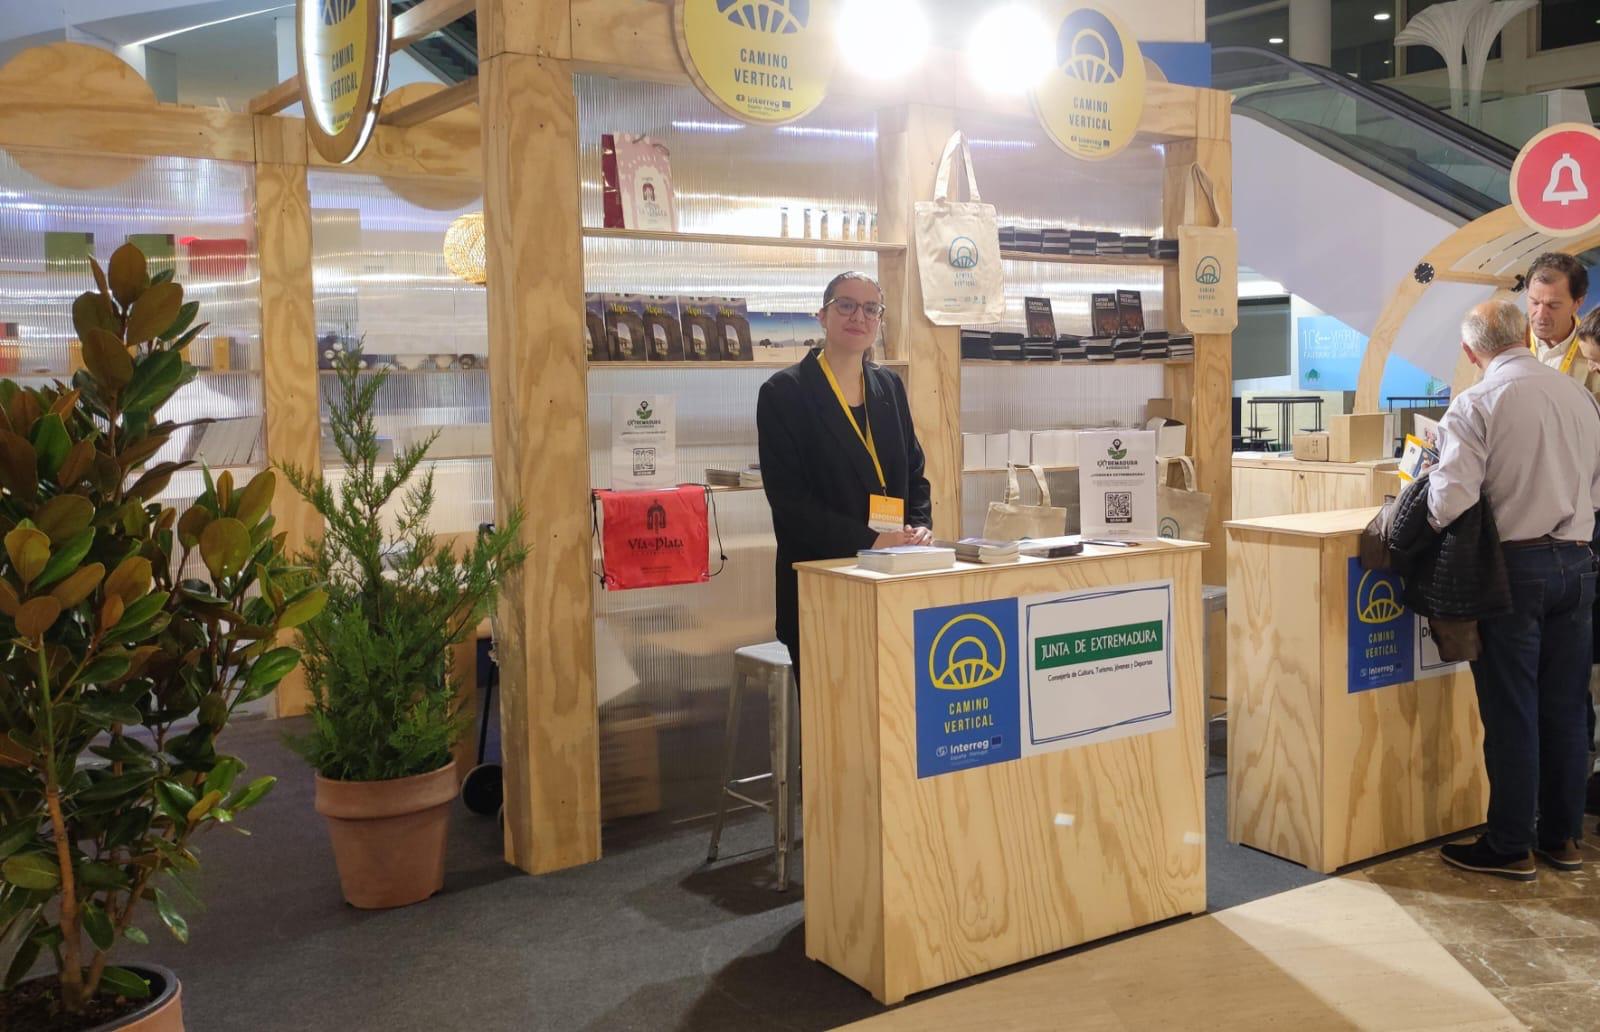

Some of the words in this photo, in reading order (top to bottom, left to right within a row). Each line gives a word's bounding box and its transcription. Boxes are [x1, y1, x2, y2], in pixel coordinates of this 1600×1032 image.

[331, 42, 354, 72] CAMINO
[740, 48, 788, 69] CAMINO
[330, 71, 358, 102] VERTICAL
[734, 68, 793, 91] VERTICAL
[1073, 96, 1108, 113] CAMINO
[1069, 112, 1112, 132] VERTICAL
[1041, 642, 1070, 661] JUNTA
[1074, 639, 1087, 654] DE
[1091, 629, 1158, 651] EXTREMADURA
[1368, 630, 1395, 644] CAMINO
[1365, 644, 1398, 659] VERTICAL
[1368, 665, 1394, 675] Interreg
[949, 696, 989, 716] CAMINO
[944, 714, 994, 734] VERTICAL
[950, 739, 989, 755] Interreg
